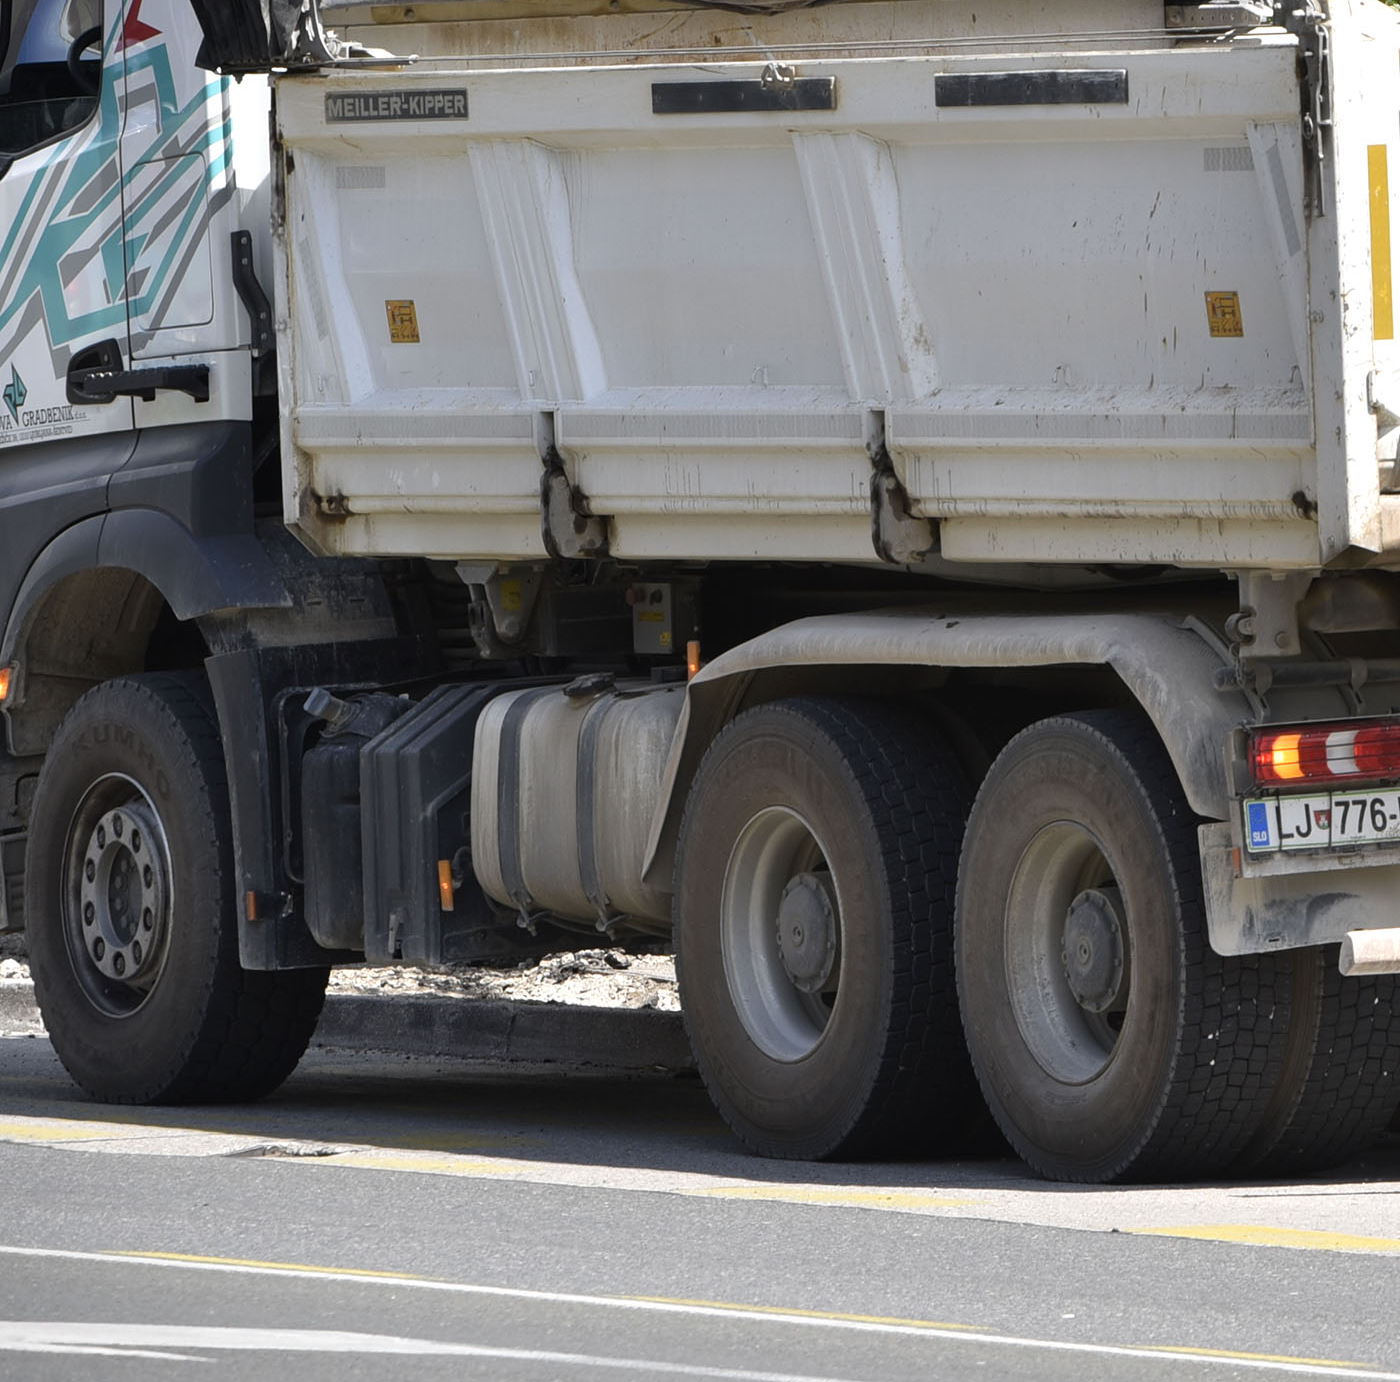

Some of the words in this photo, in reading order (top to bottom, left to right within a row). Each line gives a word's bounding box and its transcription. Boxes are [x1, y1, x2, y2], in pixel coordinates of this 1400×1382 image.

[327, 94, 466, 117] MEILLER-KIPPER
[22, 405, 75, 427] GRADBENIK
[1275, 802, 1313, 840] LJ
[1252, 831, 1268, 843] SLO
